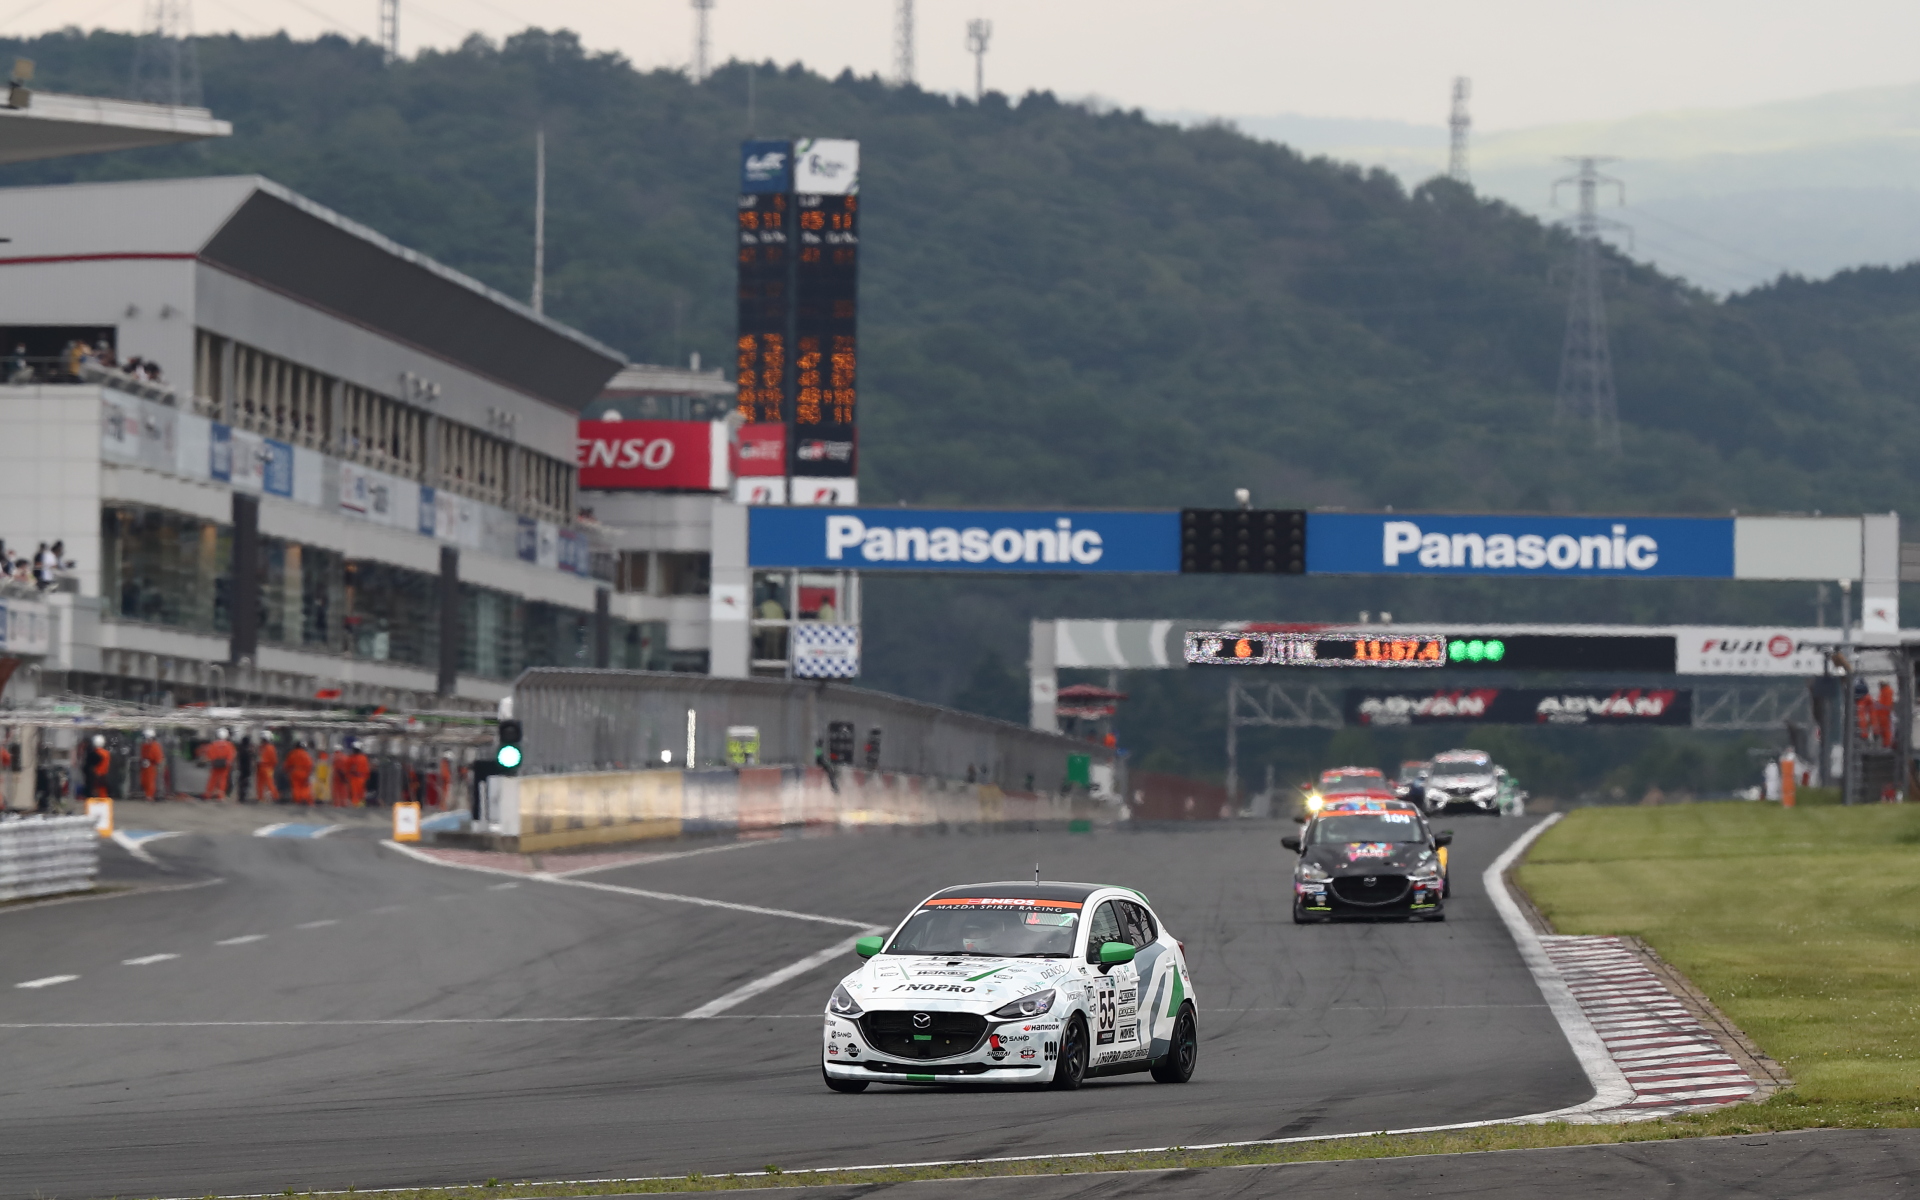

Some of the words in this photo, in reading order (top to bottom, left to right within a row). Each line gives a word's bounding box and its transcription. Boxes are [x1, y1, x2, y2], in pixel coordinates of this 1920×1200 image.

[826, 516, 1102, 563] Panasonic
[1383, 521, 1657, 569] Panasonic
[1537, 696, 1663, 716] ADVAN
[980, 898, 1035, 906] ENEOS
[1040, 964, 1065, 980] DENSO
[905, 983, 976, 993] NOPRO
[1099, 989, 1116, 1030] 55
